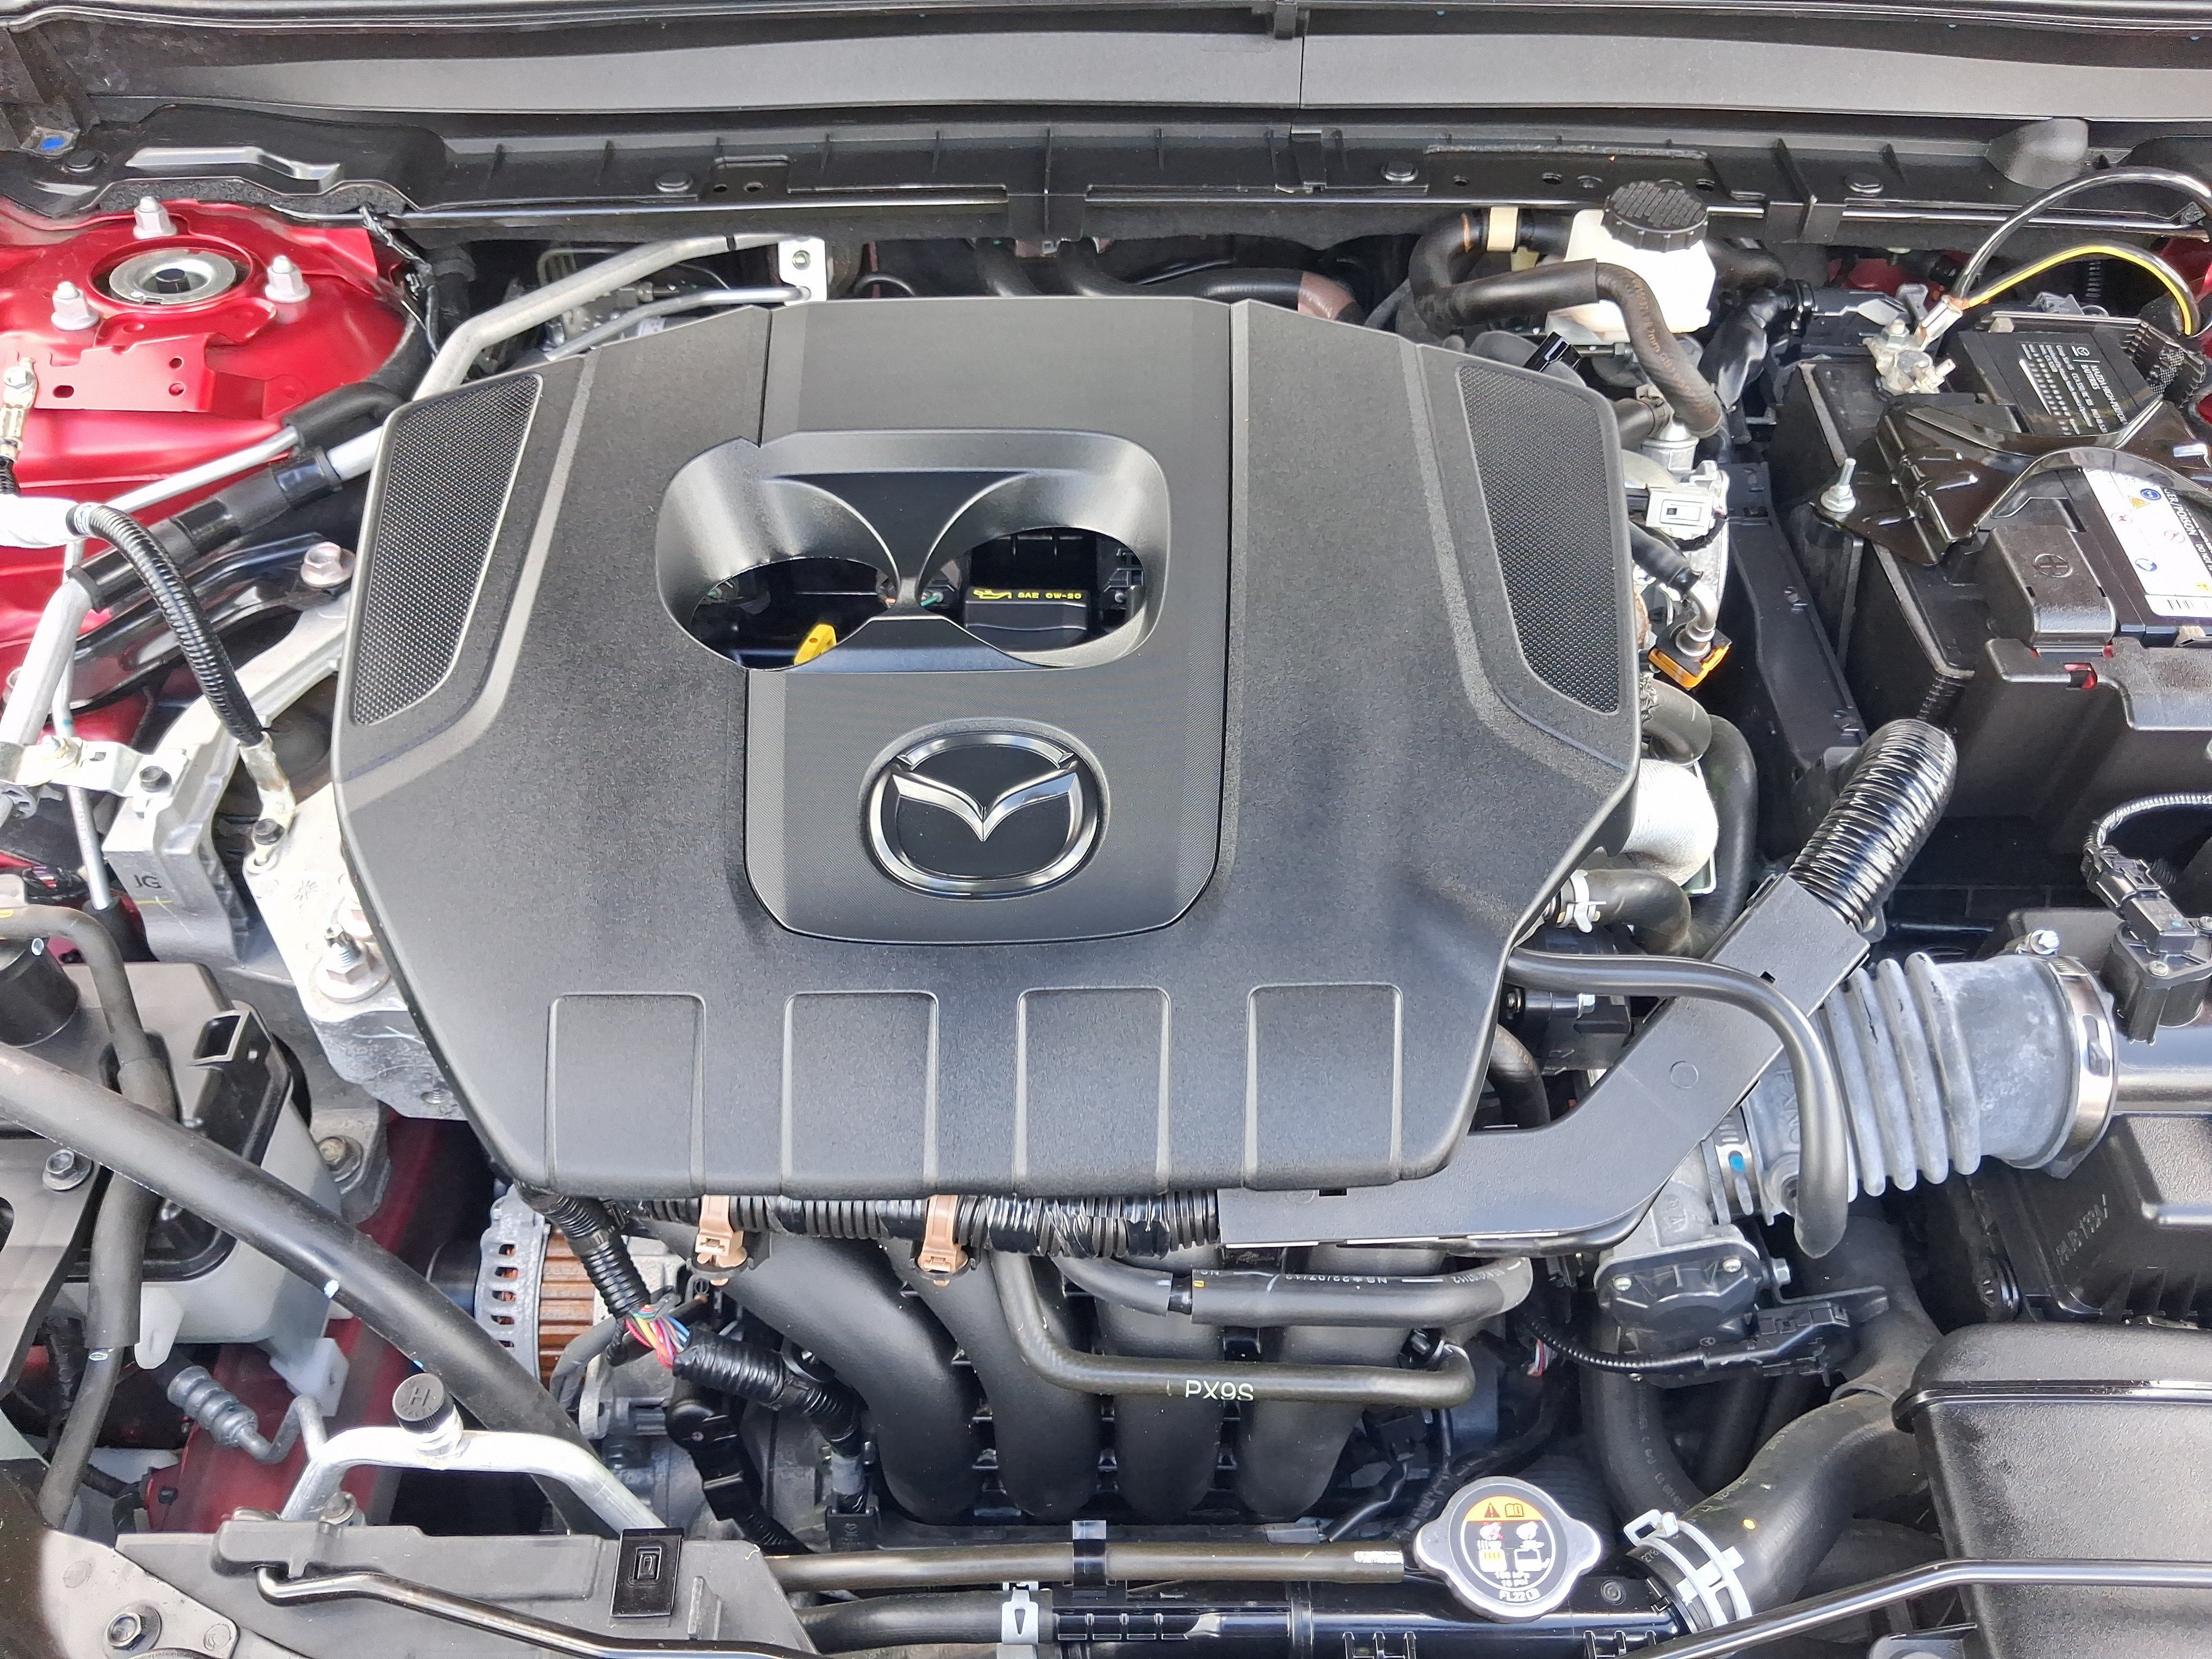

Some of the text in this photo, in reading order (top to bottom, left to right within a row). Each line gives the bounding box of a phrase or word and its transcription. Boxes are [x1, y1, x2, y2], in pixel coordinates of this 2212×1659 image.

[2081, 364, 2101, 390] BATTERIES
[409, 1386, 430, 1406] H
[1185, 1379, 1254, 1401] PX9S
[1499, 1590, 1526, 1602] FL22
